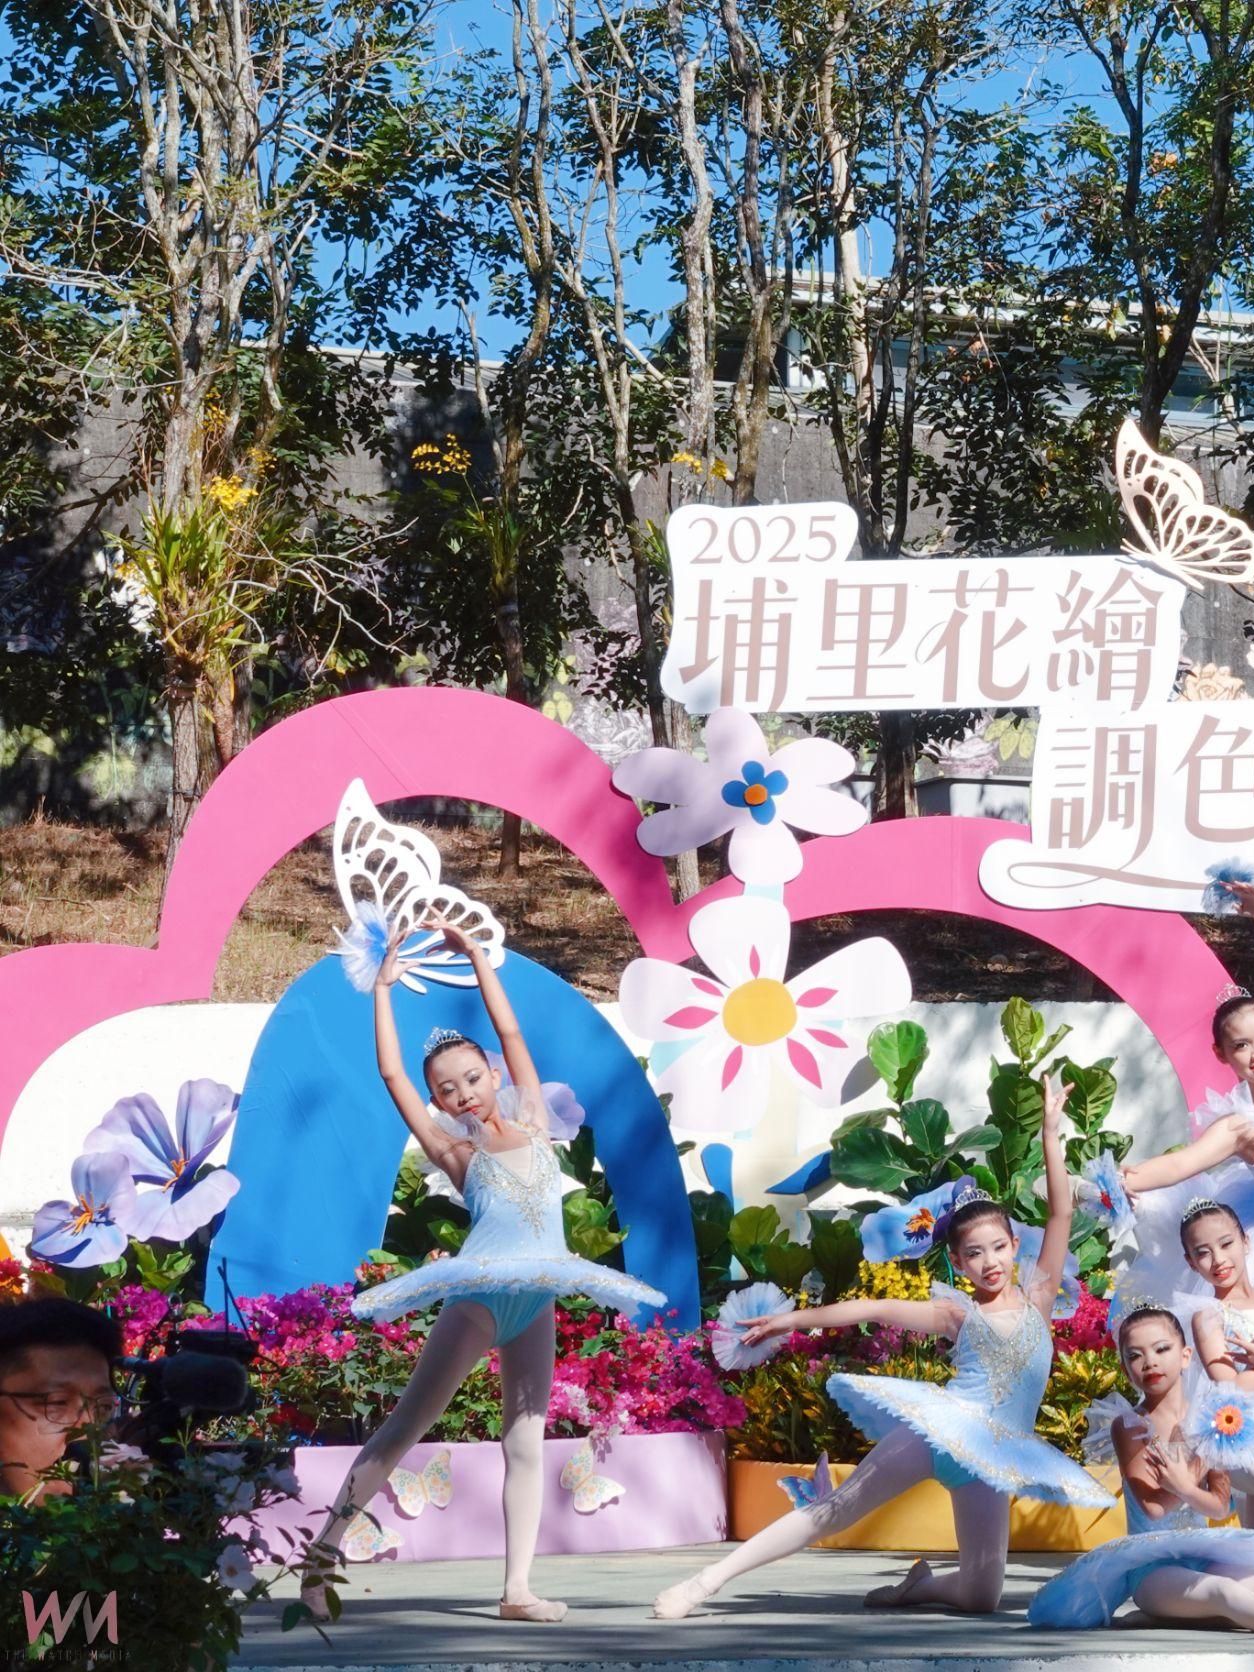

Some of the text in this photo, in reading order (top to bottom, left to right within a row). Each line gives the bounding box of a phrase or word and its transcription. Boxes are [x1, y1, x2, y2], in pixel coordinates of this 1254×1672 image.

[688, 514, 837, 564] 2025
[681, 567, 1165, 713] 埔里花繪
